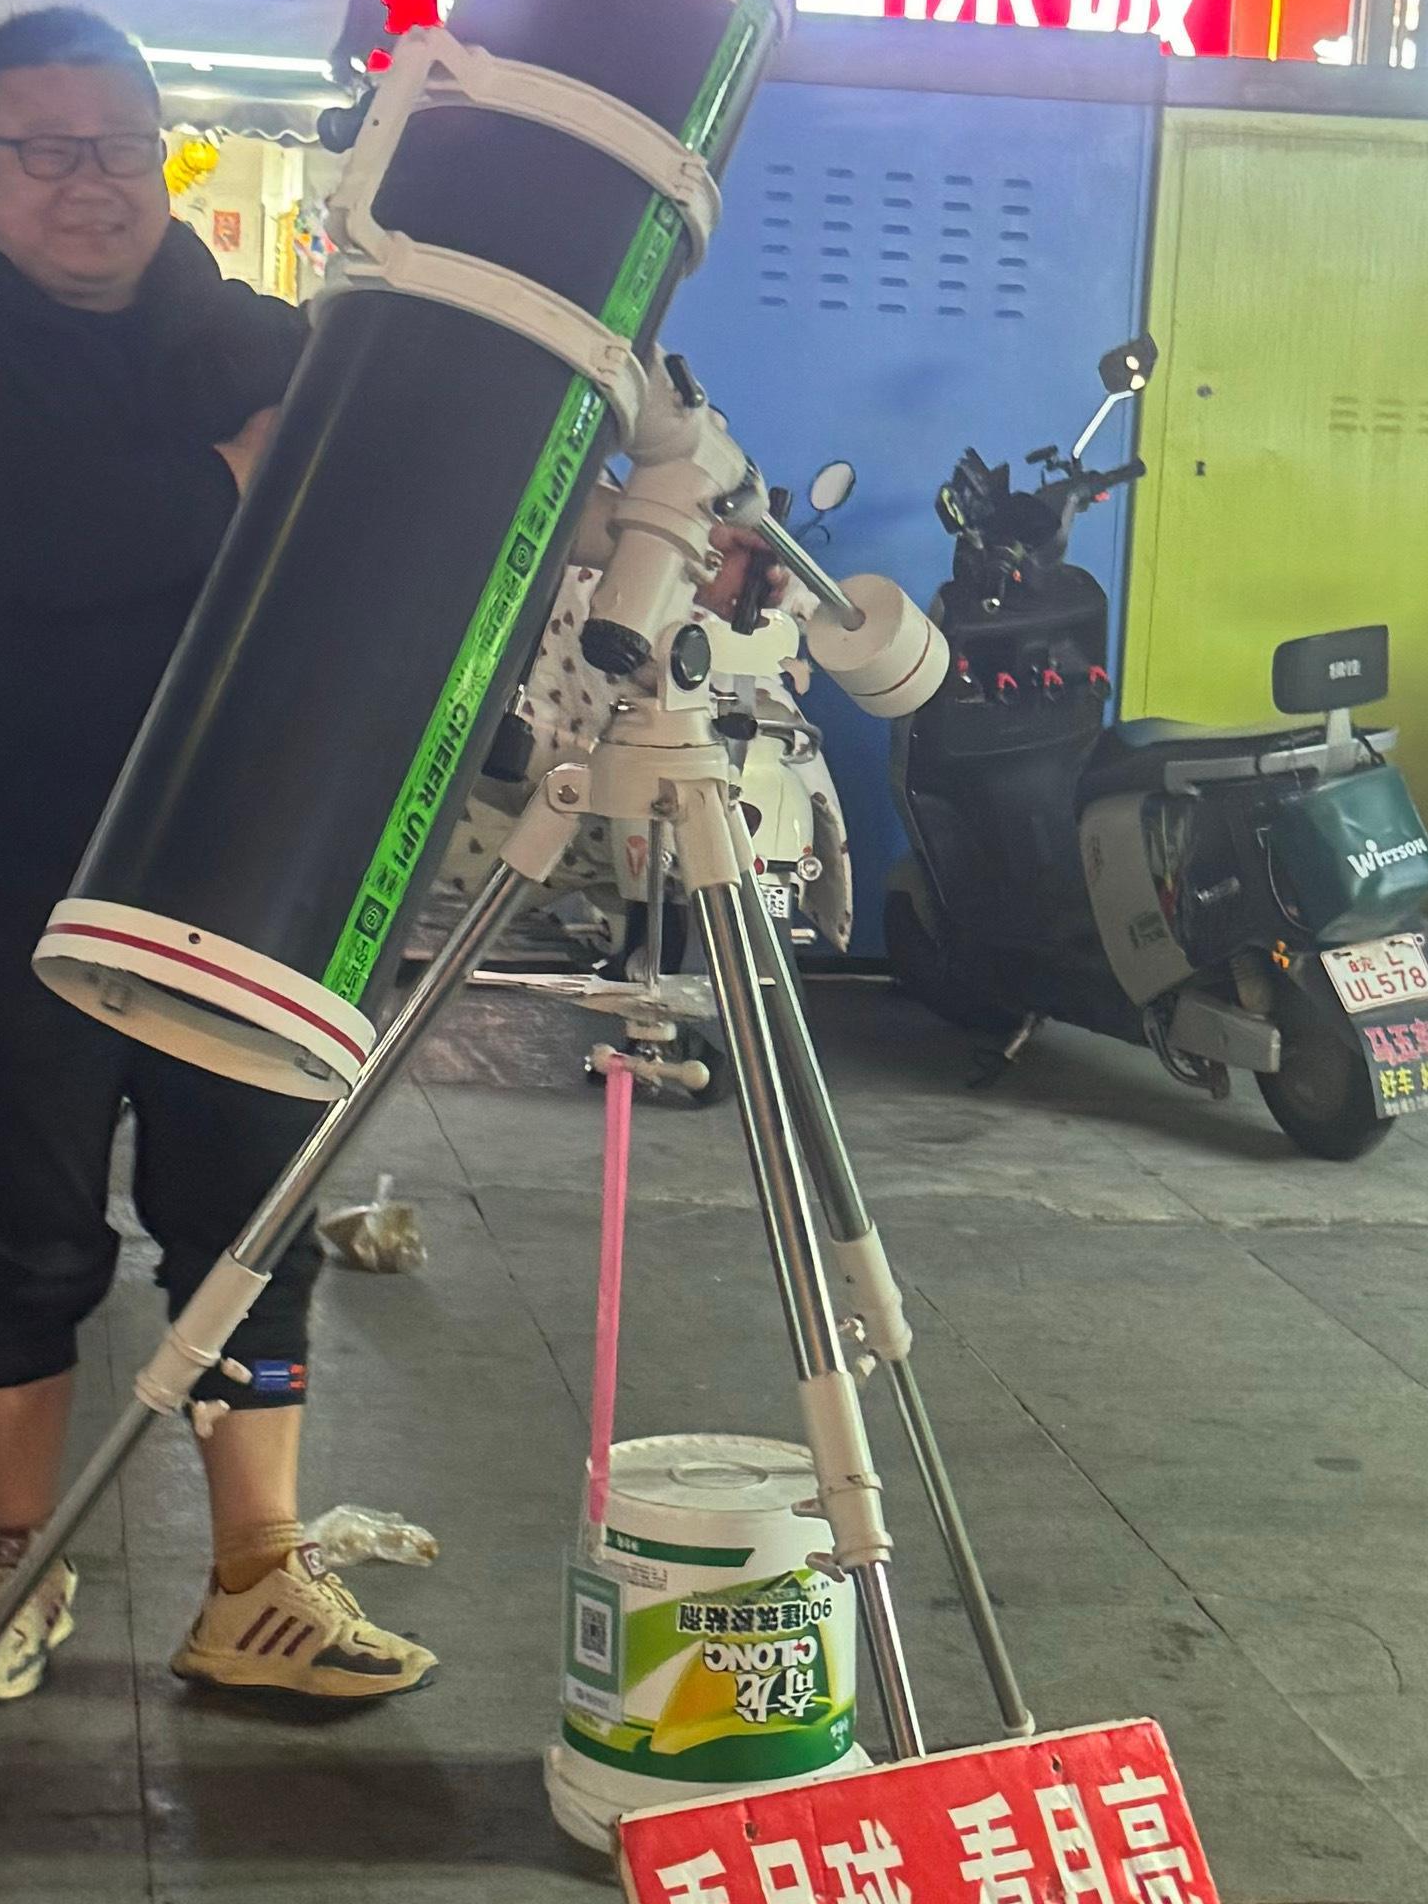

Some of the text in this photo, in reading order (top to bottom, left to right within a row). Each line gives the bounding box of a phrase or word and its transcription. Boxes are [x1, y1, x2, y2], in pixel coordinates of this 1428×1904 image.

[416, 702, 470, 809] CHEER
[1345, 967, 1428, 1003] UL578
[735, 1668, 818, 1723] 奇龙
